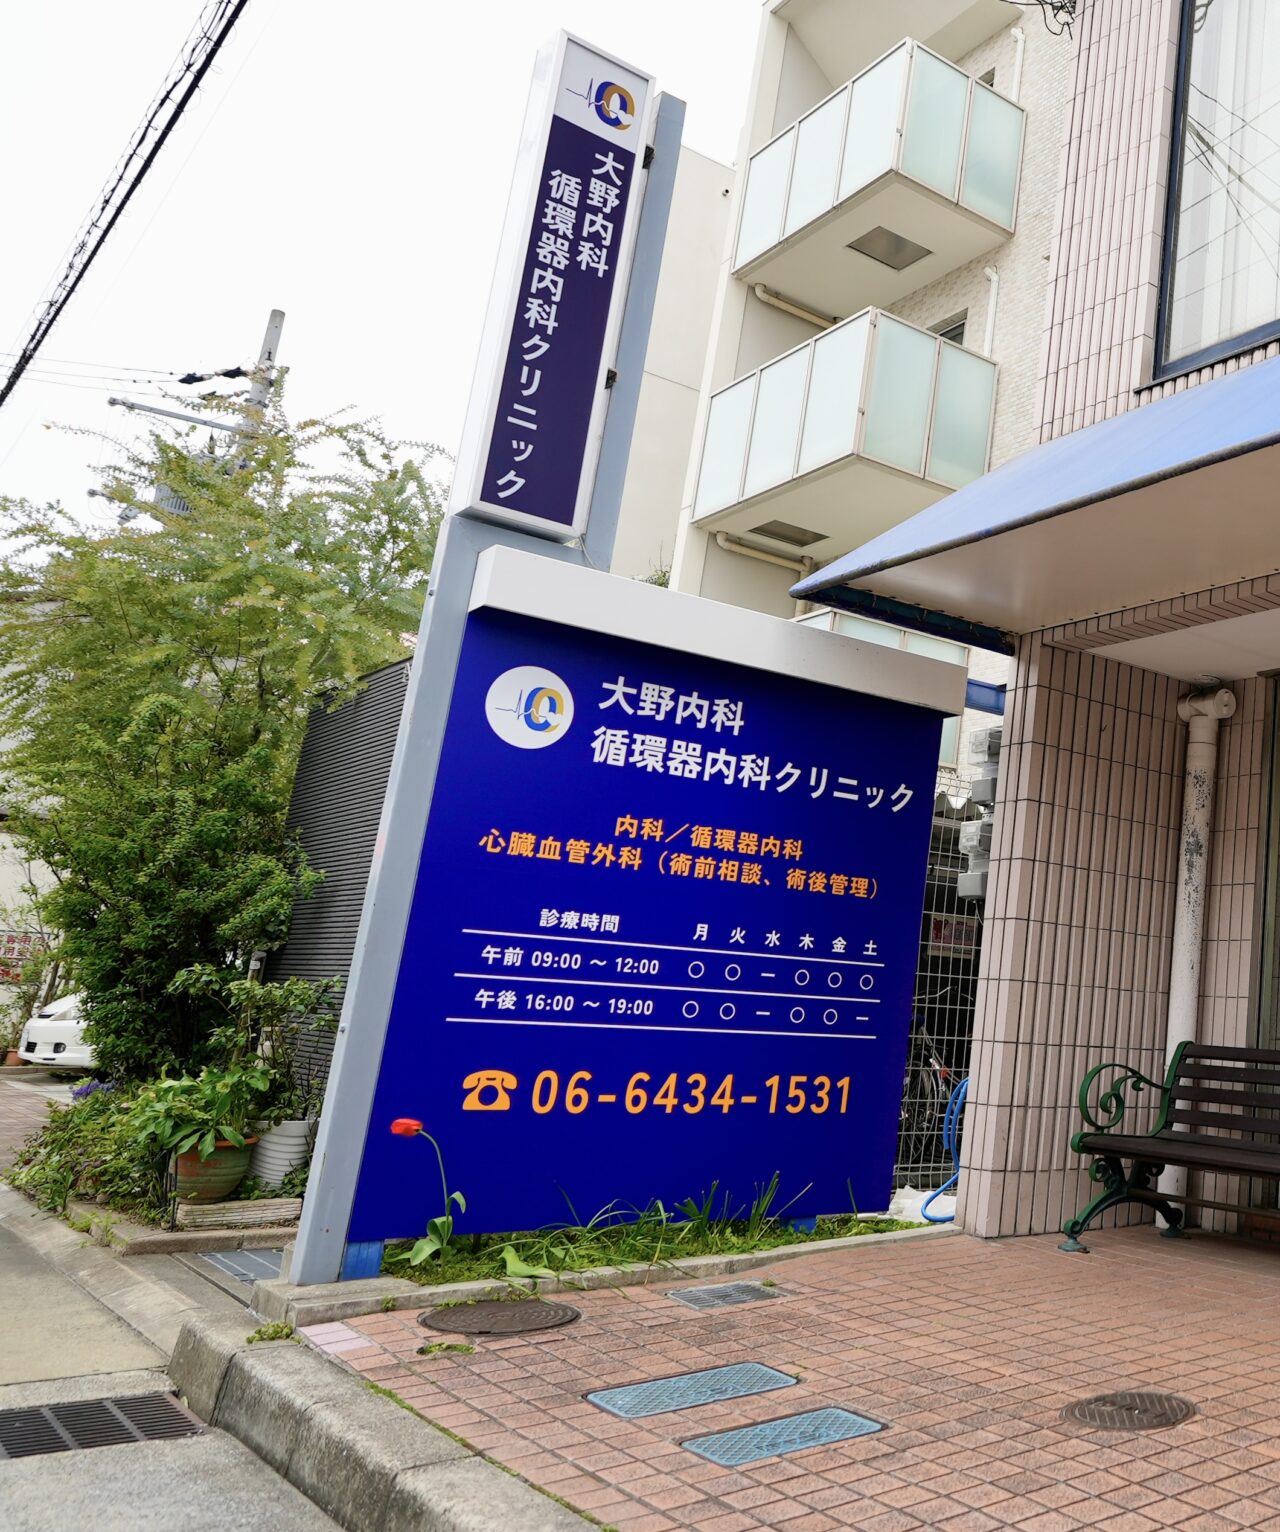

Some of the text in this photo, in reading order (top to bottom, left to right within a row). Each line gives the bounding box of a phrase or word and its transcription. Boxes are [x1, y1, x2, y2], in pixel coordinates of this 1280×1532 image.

[576, 151, 626, 279] 大野内科
[495, 168, 583, 500] 循環器内科クリニック
[598, 675, 745, 736] 大野内科
[590, 725, 915, 813] 循環器内科クリニック
[614, 814, 804, 861] 内科／循環器内科
[478, 828, 878, 900] 心臓血管外科（術前相談、術後管理）
[539, 908, 620, 934] 診療時間
[692, 923, 877, 956] 月 火 水 木 金 土
[481, 944, 525, 967] 午前
[531, 950, 582, 970] 09:00
[614, 957, 660, 975] 12:00
[474, 988, 517, 1011] 午後
[525, 993, 575, 1012] 16:00
[608, 998, 654, 1016] 19:00
[531, 1069, 851, 1115] 06-6434-1531
